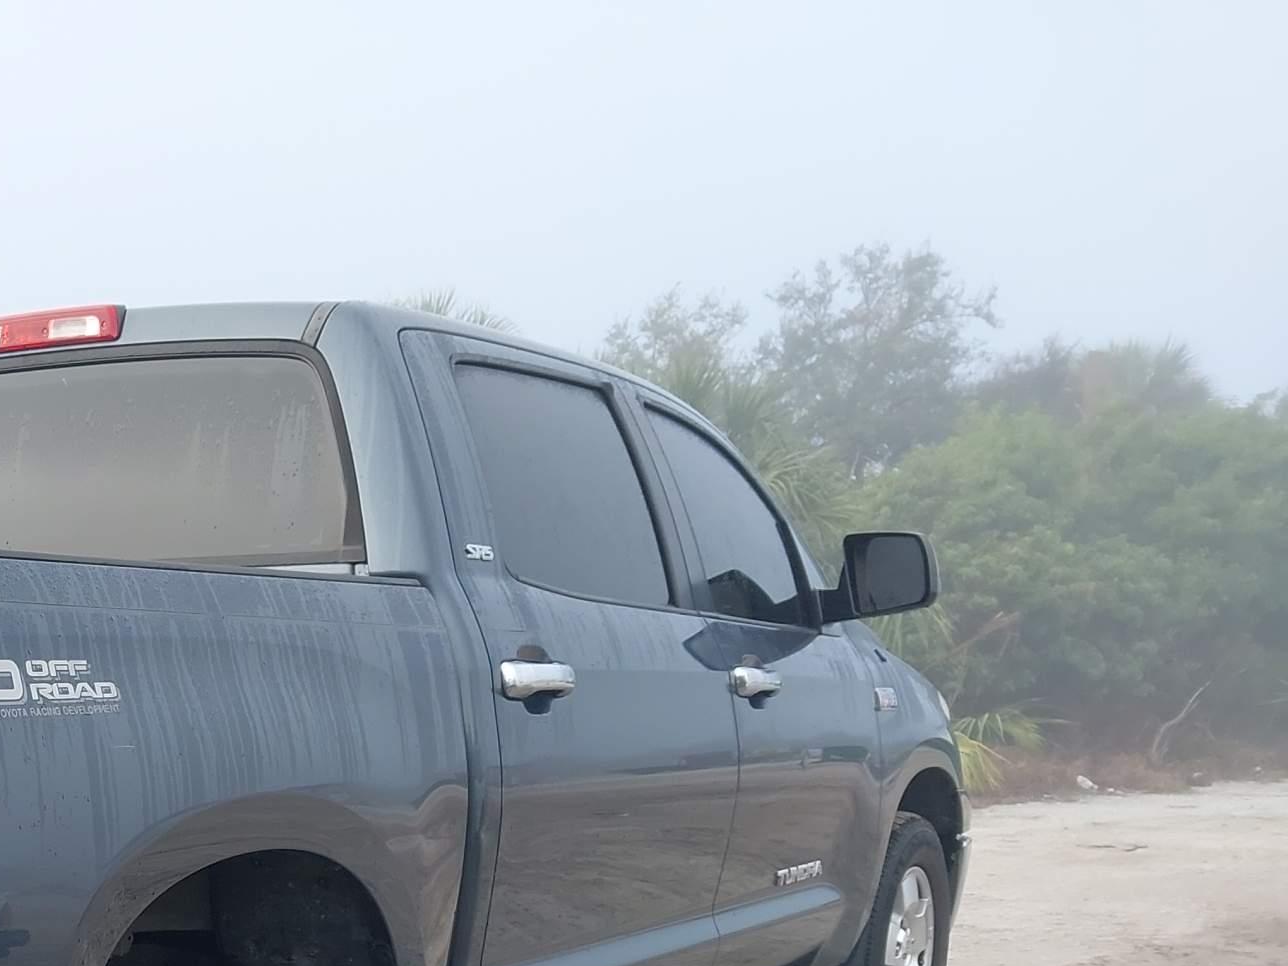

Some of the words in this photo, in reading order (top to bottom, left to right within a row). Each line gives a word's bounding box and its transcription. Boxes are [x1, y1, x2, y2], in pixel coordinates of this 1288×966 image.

[25, 660, 89, 679] OFF
[29, 682, 120, 703] ROAD
[30, 706, 61, 717] RACING
[62, 704, 120, 715] DEVELOPMENT
[776, 859, 823, 887] TUNDRA
